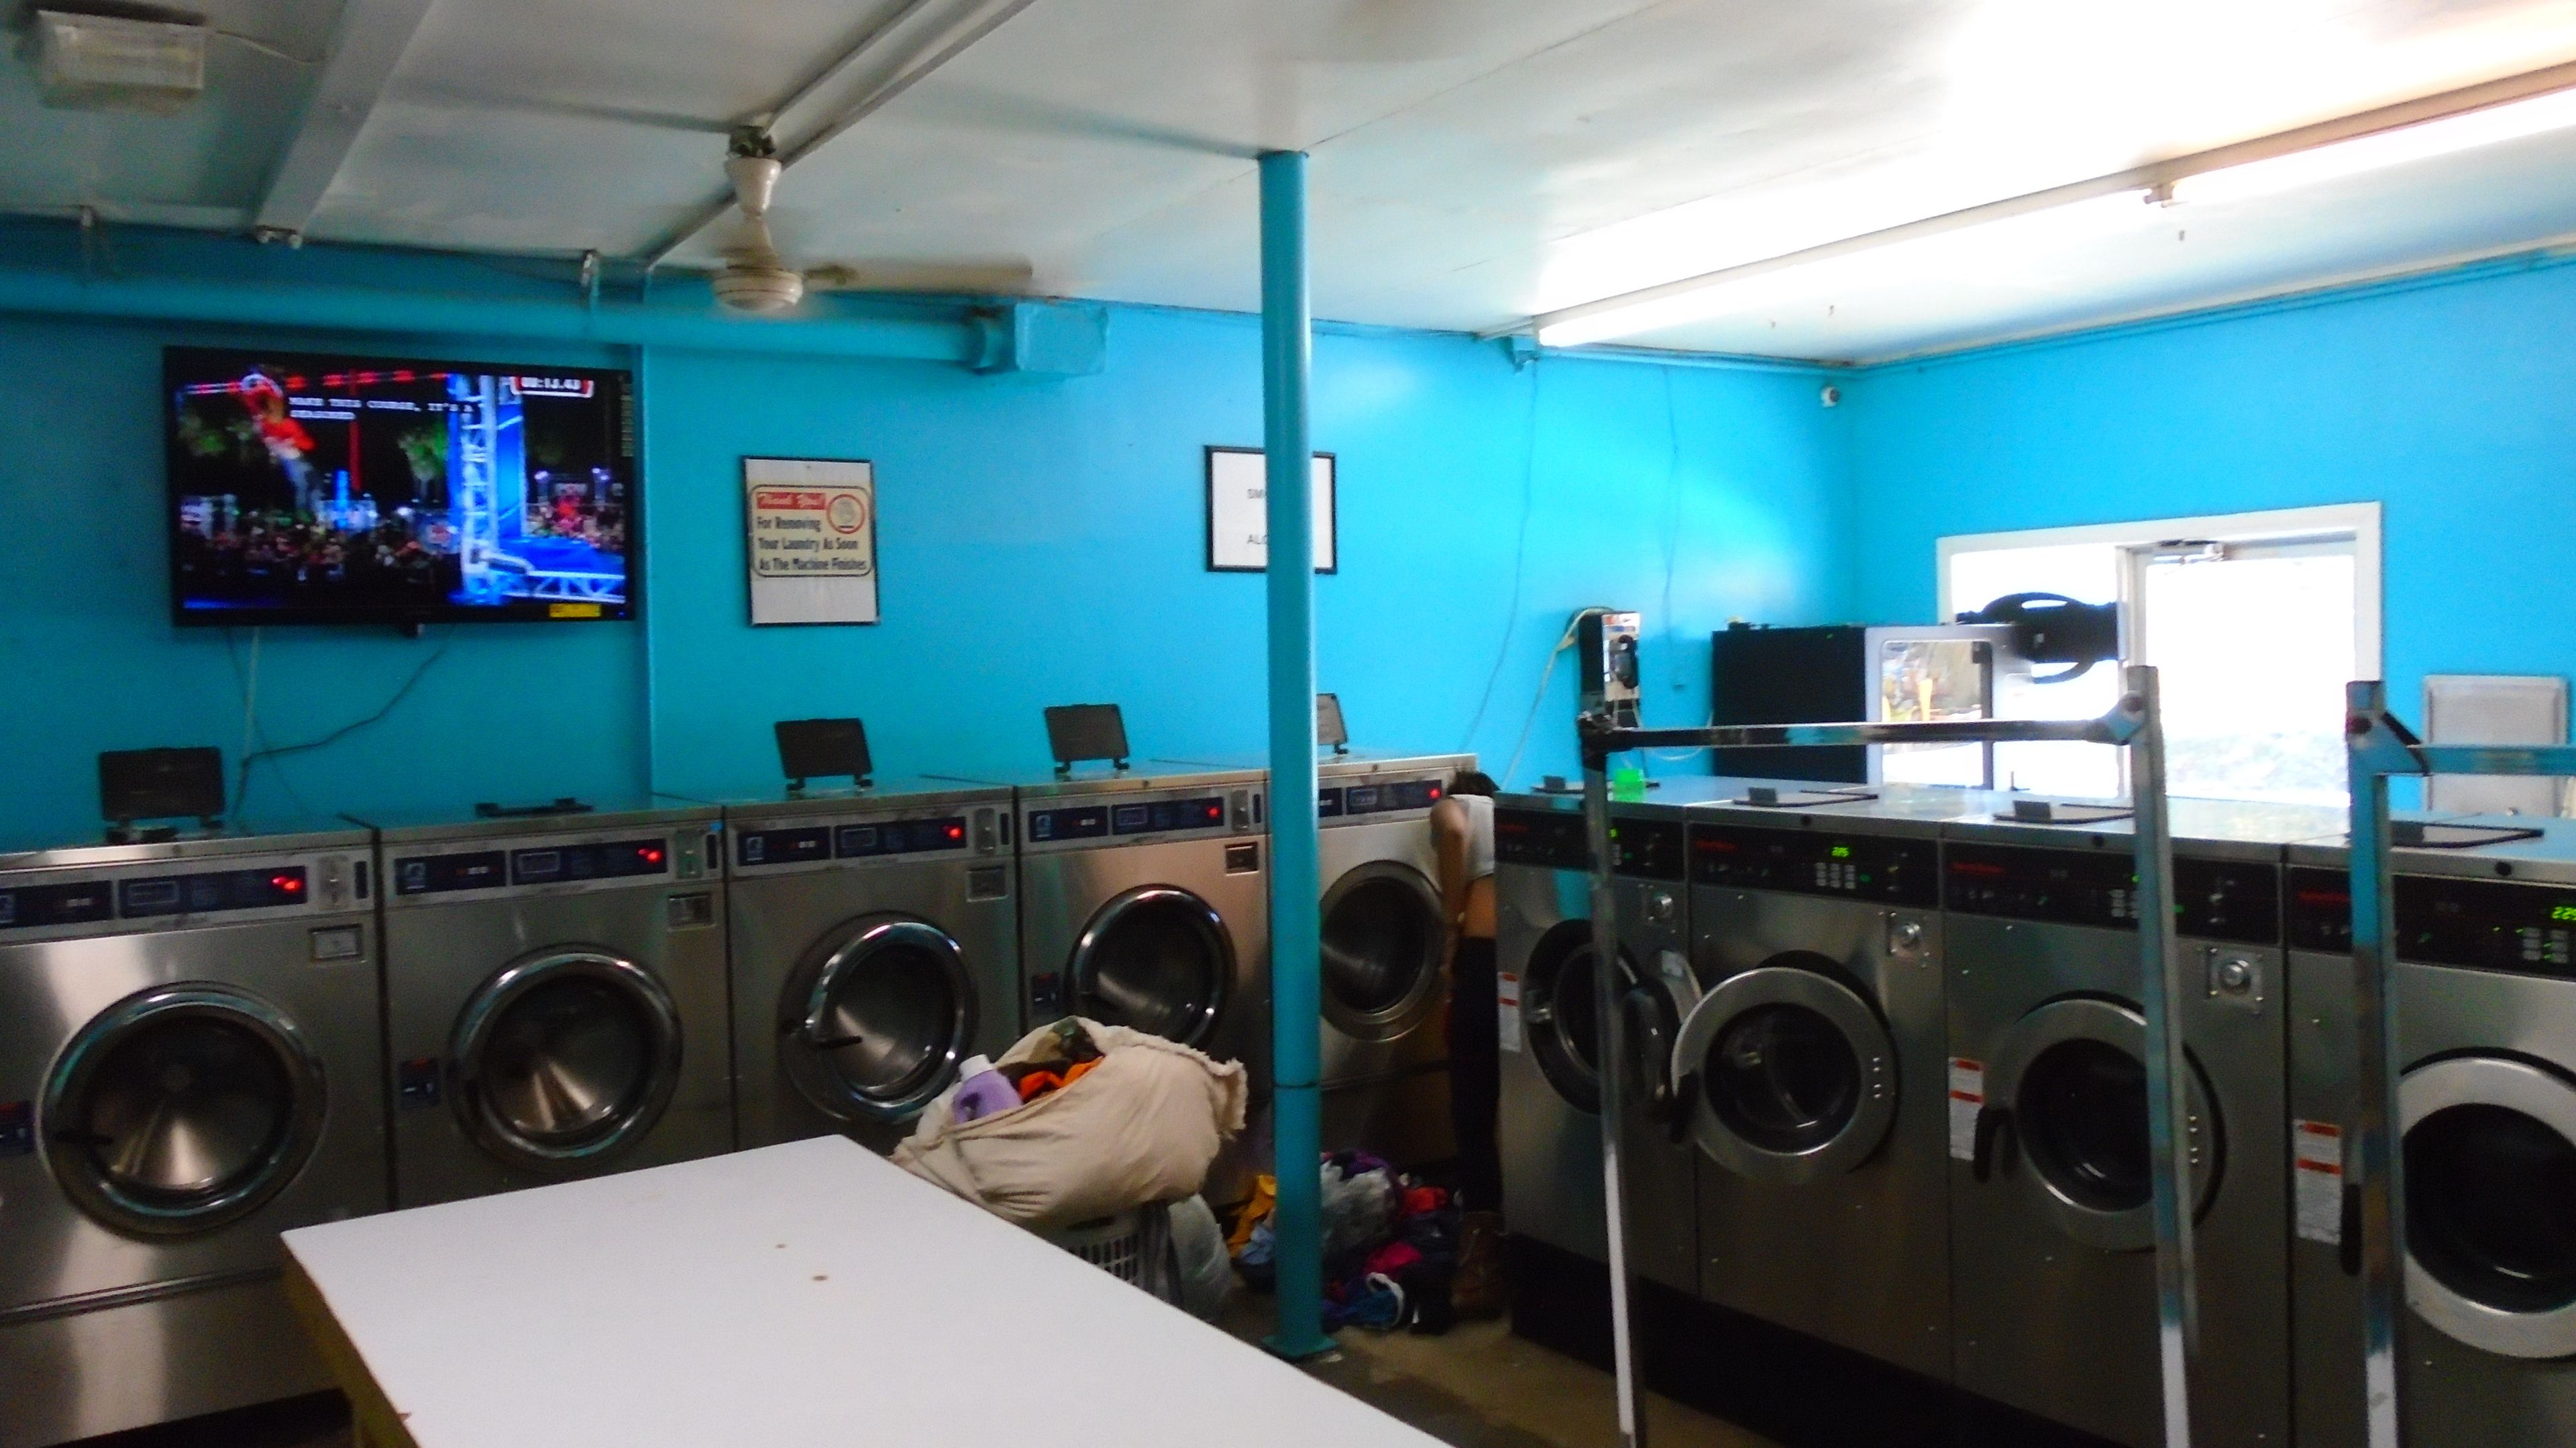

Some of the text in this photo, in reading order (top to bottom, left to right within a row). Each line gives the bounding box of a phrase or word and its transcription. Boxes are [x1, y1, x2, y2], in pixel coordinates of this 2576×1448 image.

[757, 517, 820, 532] For Removing
[759, 537, 859, 552] Your Laundry As Soon
[759, 558, 867, 570] As The Machine Finishes
